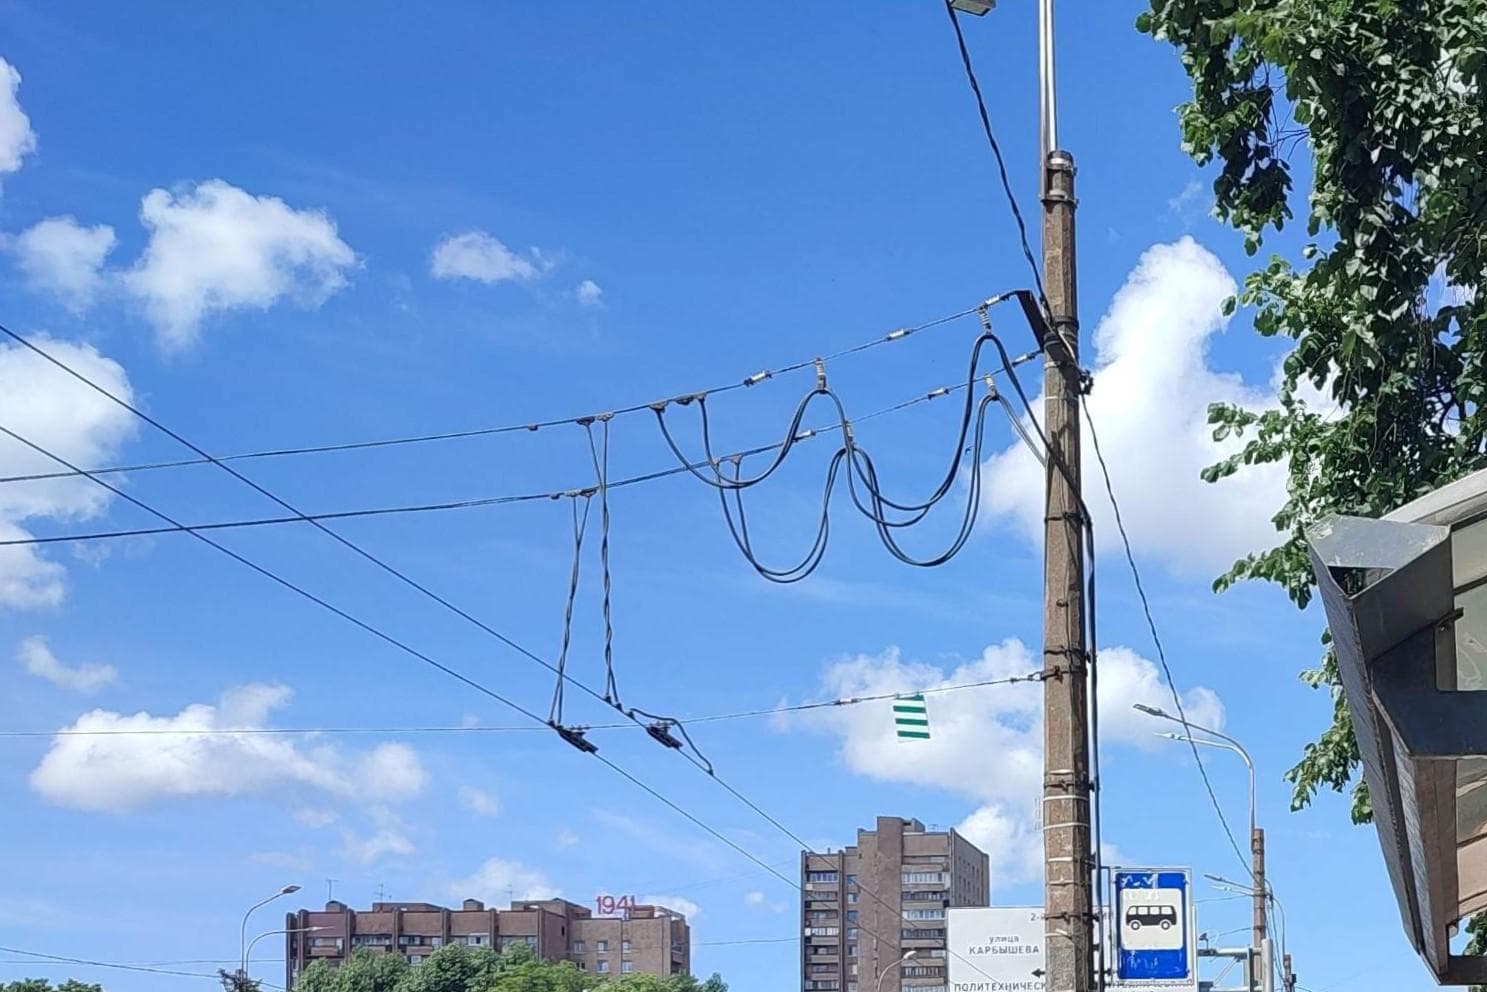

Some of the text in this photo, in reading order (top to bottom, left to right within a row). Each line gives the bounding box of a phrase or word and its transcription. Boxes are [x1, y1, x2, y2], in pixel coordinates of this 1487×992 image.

[989, 936, 1019, 944] улица
[969, 945, 1040, 955] КАРБЫШЕВА
[954, 982, 1046, 992] ПОЛИТЕХНИЧЕСК
